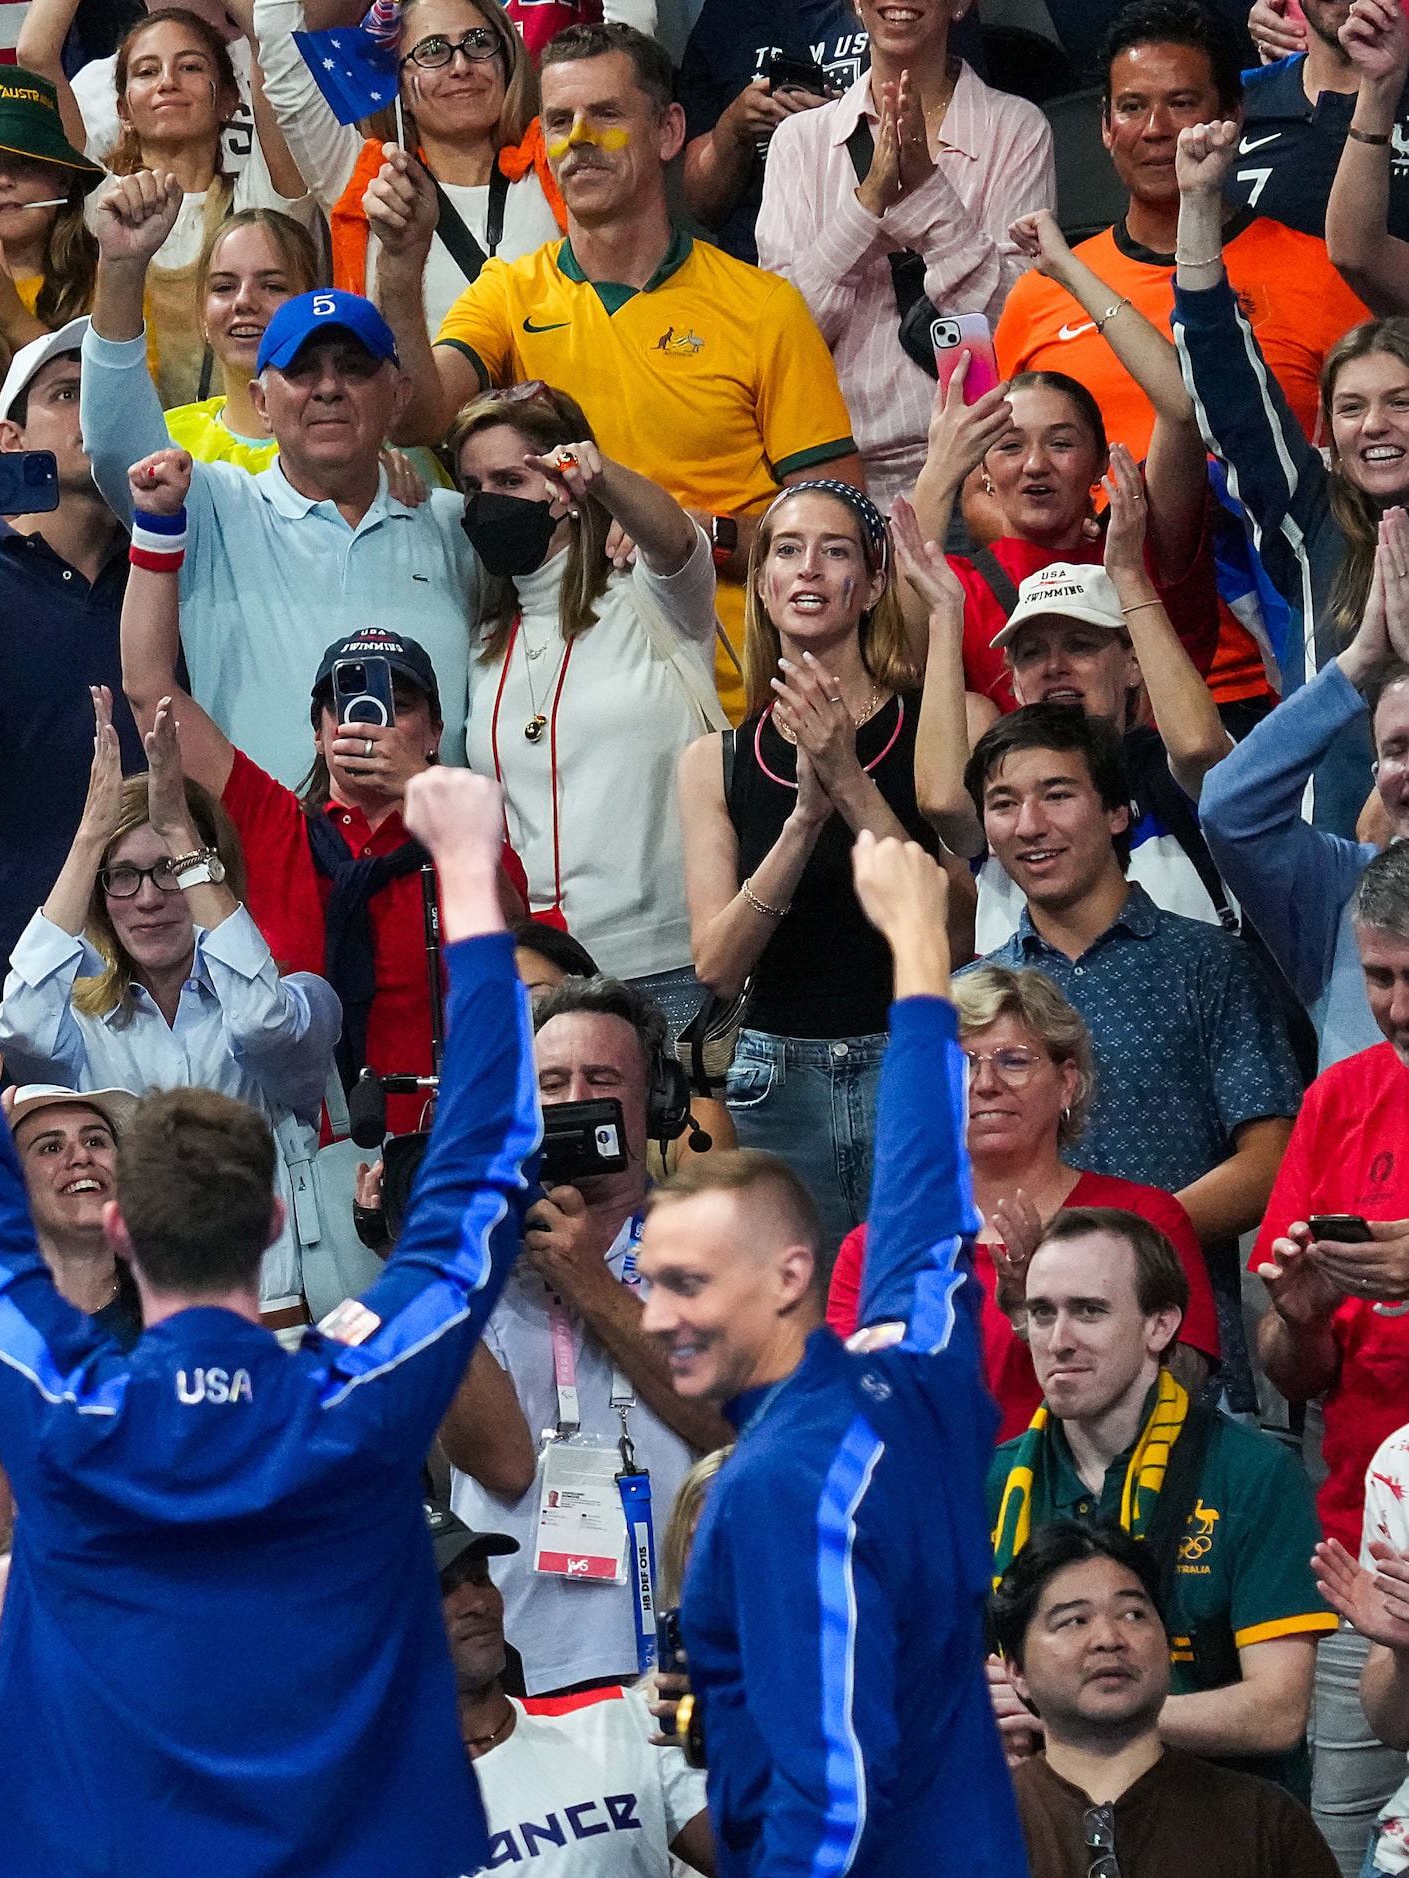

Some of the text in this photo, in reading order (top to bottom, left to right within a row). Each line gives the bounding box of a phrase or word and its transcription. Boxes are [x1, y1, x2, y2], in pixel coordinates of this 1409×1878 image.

[1237, 167, 1274, 208] 7
[313, 294, 336, 316] 5
[1041, 570, 1066, 580] USA
[1024, 585, 1085, 604] SWIMMING
[360, 628, 386, 636] USA
[340, 642, 404, 653] SWIMMING
[176, 1367, 253, 1404] USA
[641, 1571, 650, 1592] DEF
[486, 1793, 642, 1870] ANCE
